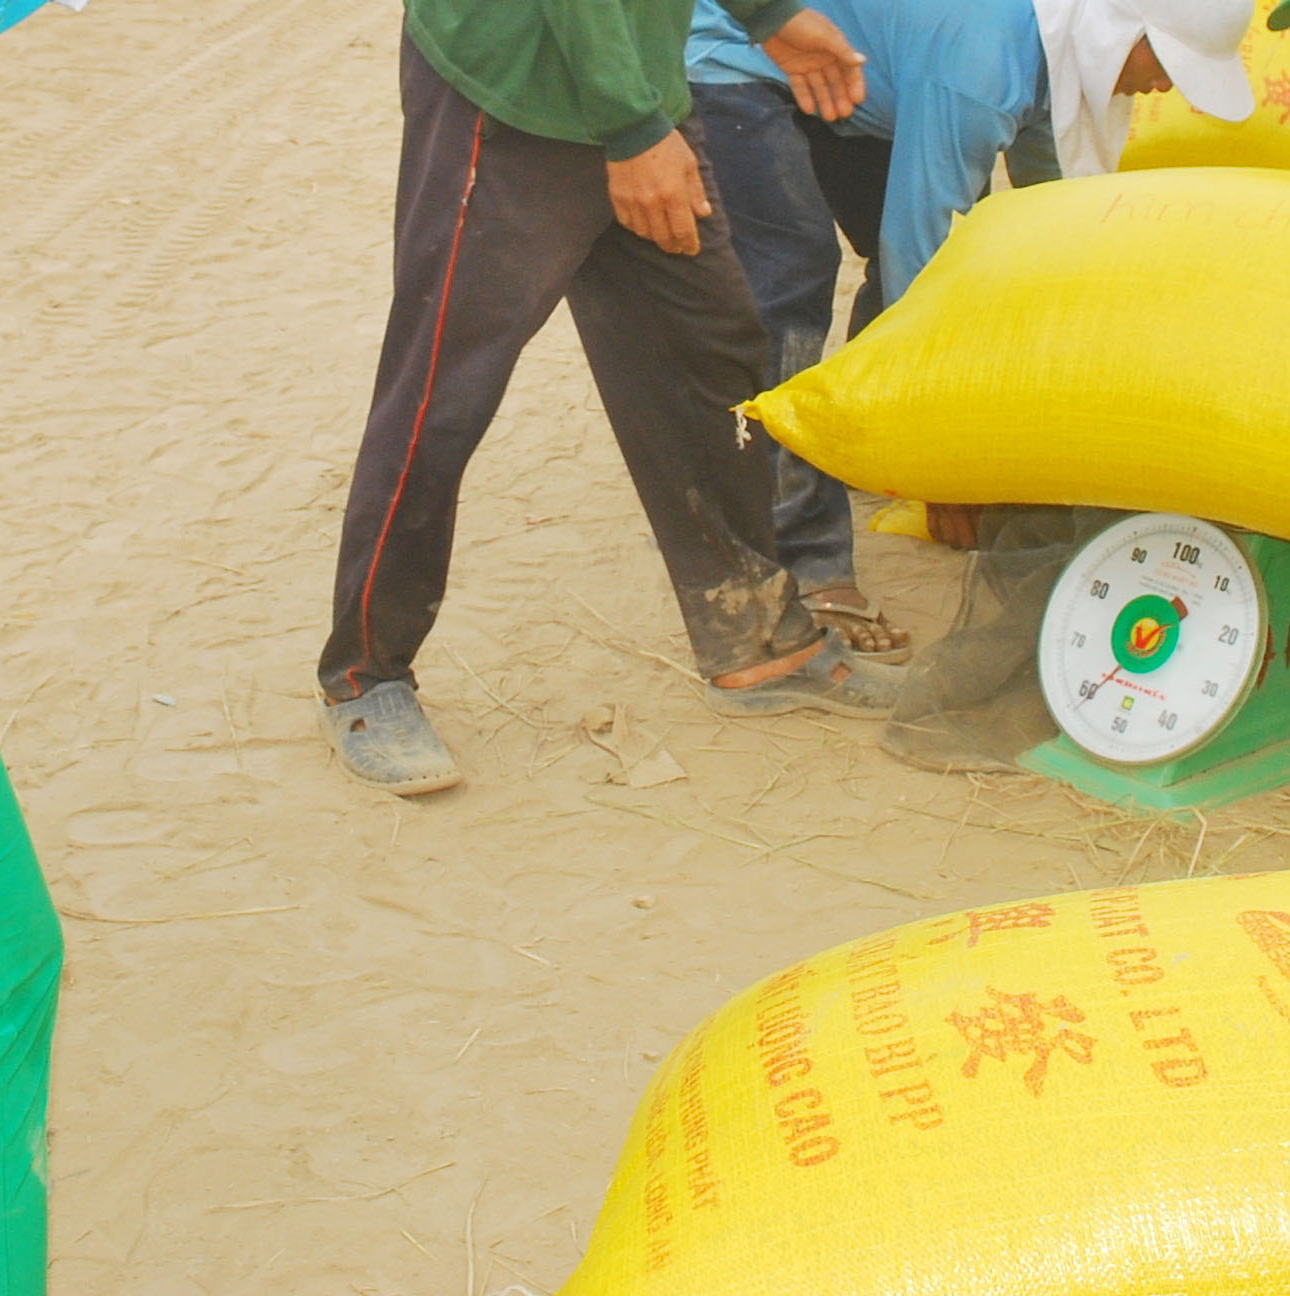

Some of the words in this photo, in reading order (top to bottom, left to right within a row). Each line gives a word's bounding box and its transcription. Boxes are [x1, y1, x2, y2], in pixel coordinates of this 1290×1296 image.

[1130, 546, 1148, 565] 90
[1172, 541, 1201, 565] 100
[1089, 579, 1110, 601] 80
[1213, 574, 1230, 593] 10
[1217, 624, 1240, 647] 20
[1078, 679, 1100, 701] 60
[1201, 679, 1220, 699] 30
[1110, 715, 1129, 735] 50
[1157, 708, 1179, 732] 40
[1105, 946, 1166, 998] CO.
[851, 981, 909, 1037] BAO
[863, 1035, 939, 1079] BÌ
[1128, 1005, 1209, 1088] LTD
[879, 1078, 944, 1131] PP
[773, 1086, 843, 1168] CAO
